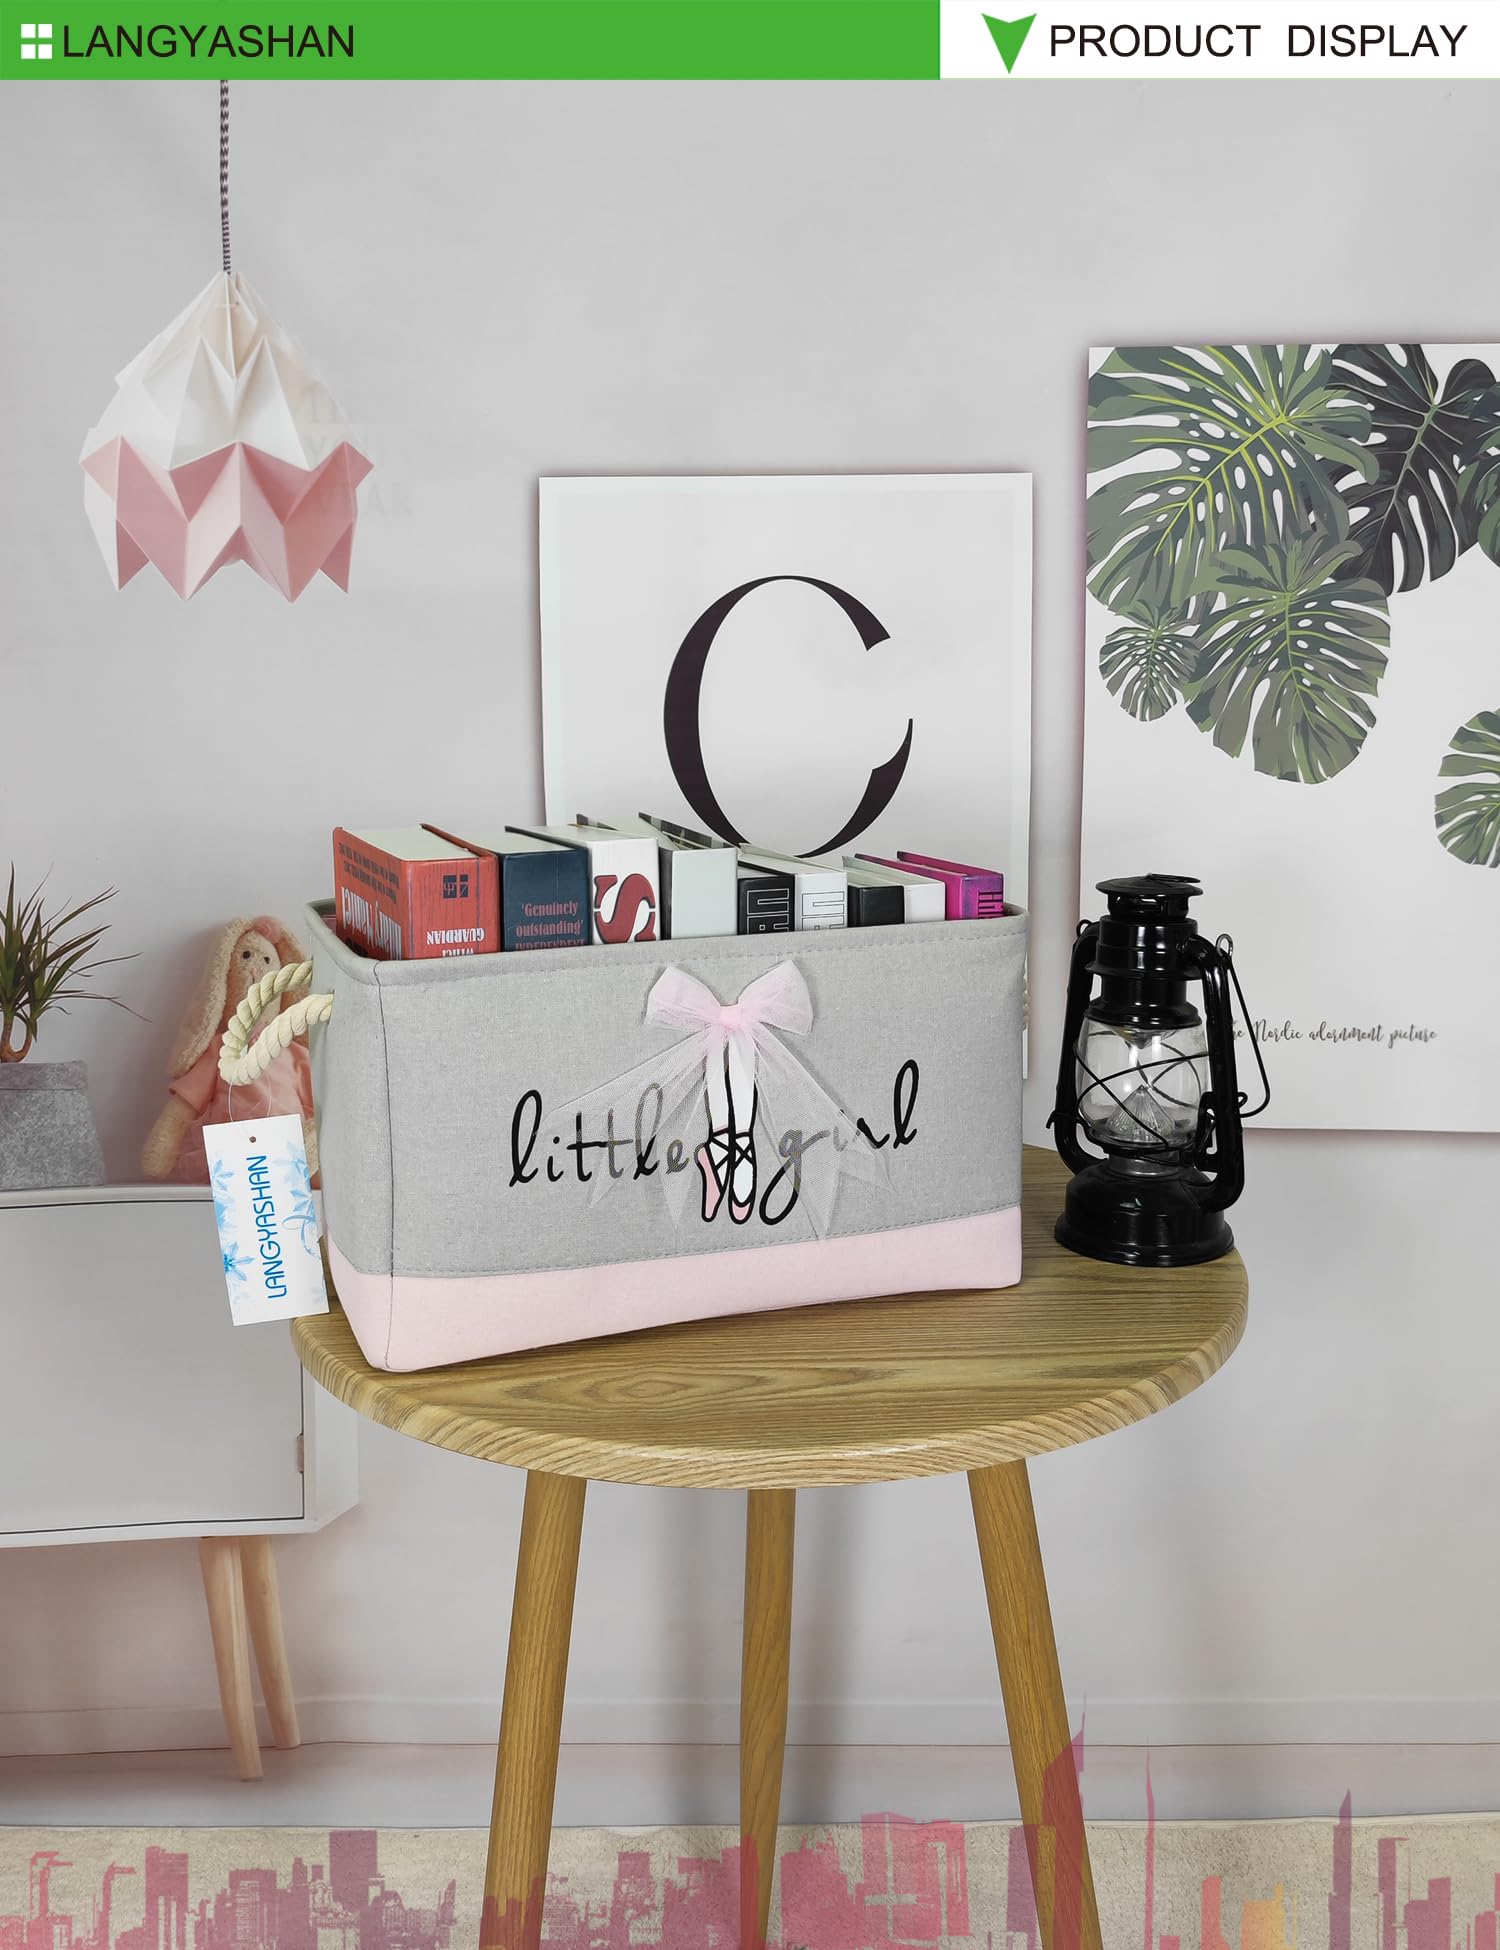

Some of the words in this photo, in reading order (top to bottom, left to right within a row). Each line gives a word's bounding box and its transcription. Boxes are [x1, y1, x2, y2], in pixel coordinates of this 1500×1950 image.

[663, 575, 914, 859] C
[427, 927, 485, 945] GUARDIAN
[1254, 1018, 1302, 1043] Nordic
[1388, 1023, 1438, 1049] picture
[508, 1083, 690, 1187] little
[758, 1058, 919, 1226] girl
[246, 1155, 288, 1299] LANGYASHAN
